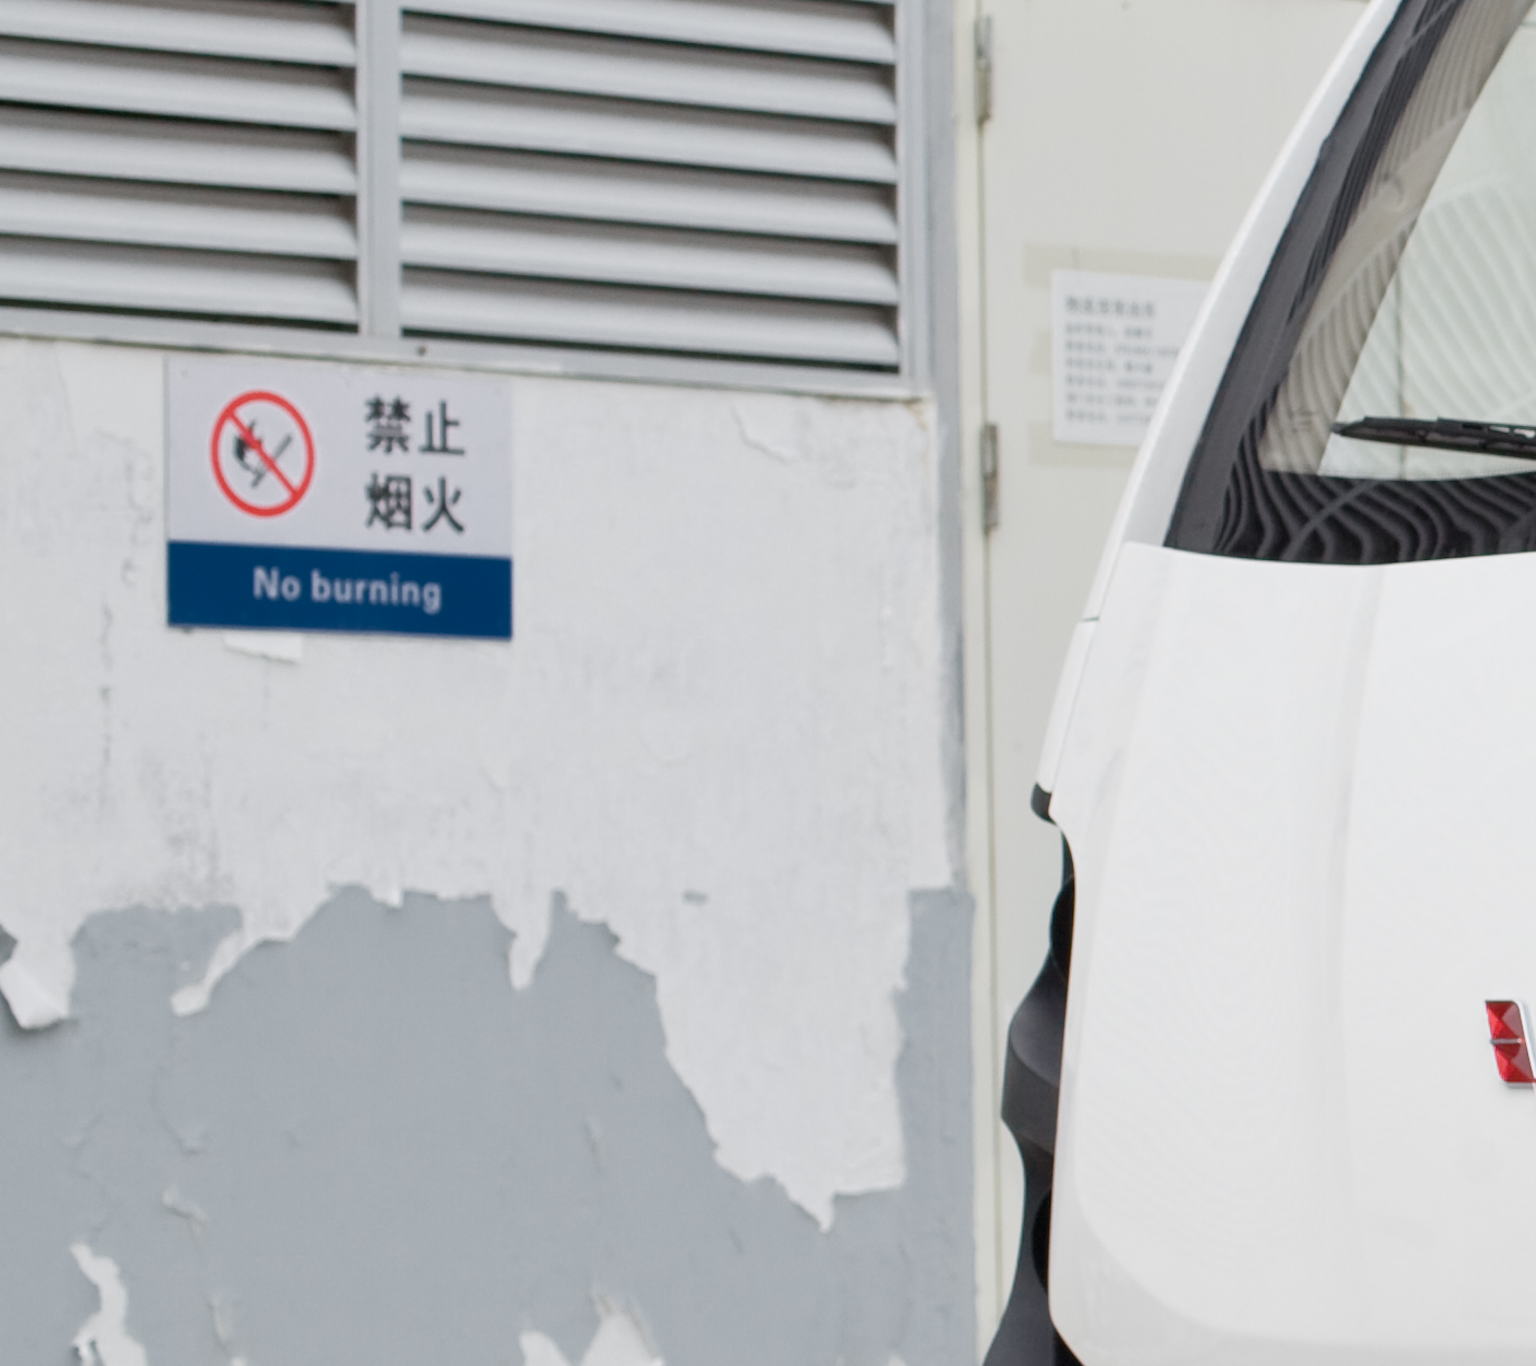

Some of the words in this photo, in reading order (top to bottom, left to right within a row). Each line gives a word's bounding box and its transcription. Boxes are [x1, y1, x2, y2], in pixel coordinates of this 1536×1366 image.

[365, 394, 465, 455] 禁止
[365, 471, 464, 532] 烟火
[253, 566, 301, 601] No
[310, 568, 442, 614] burning
